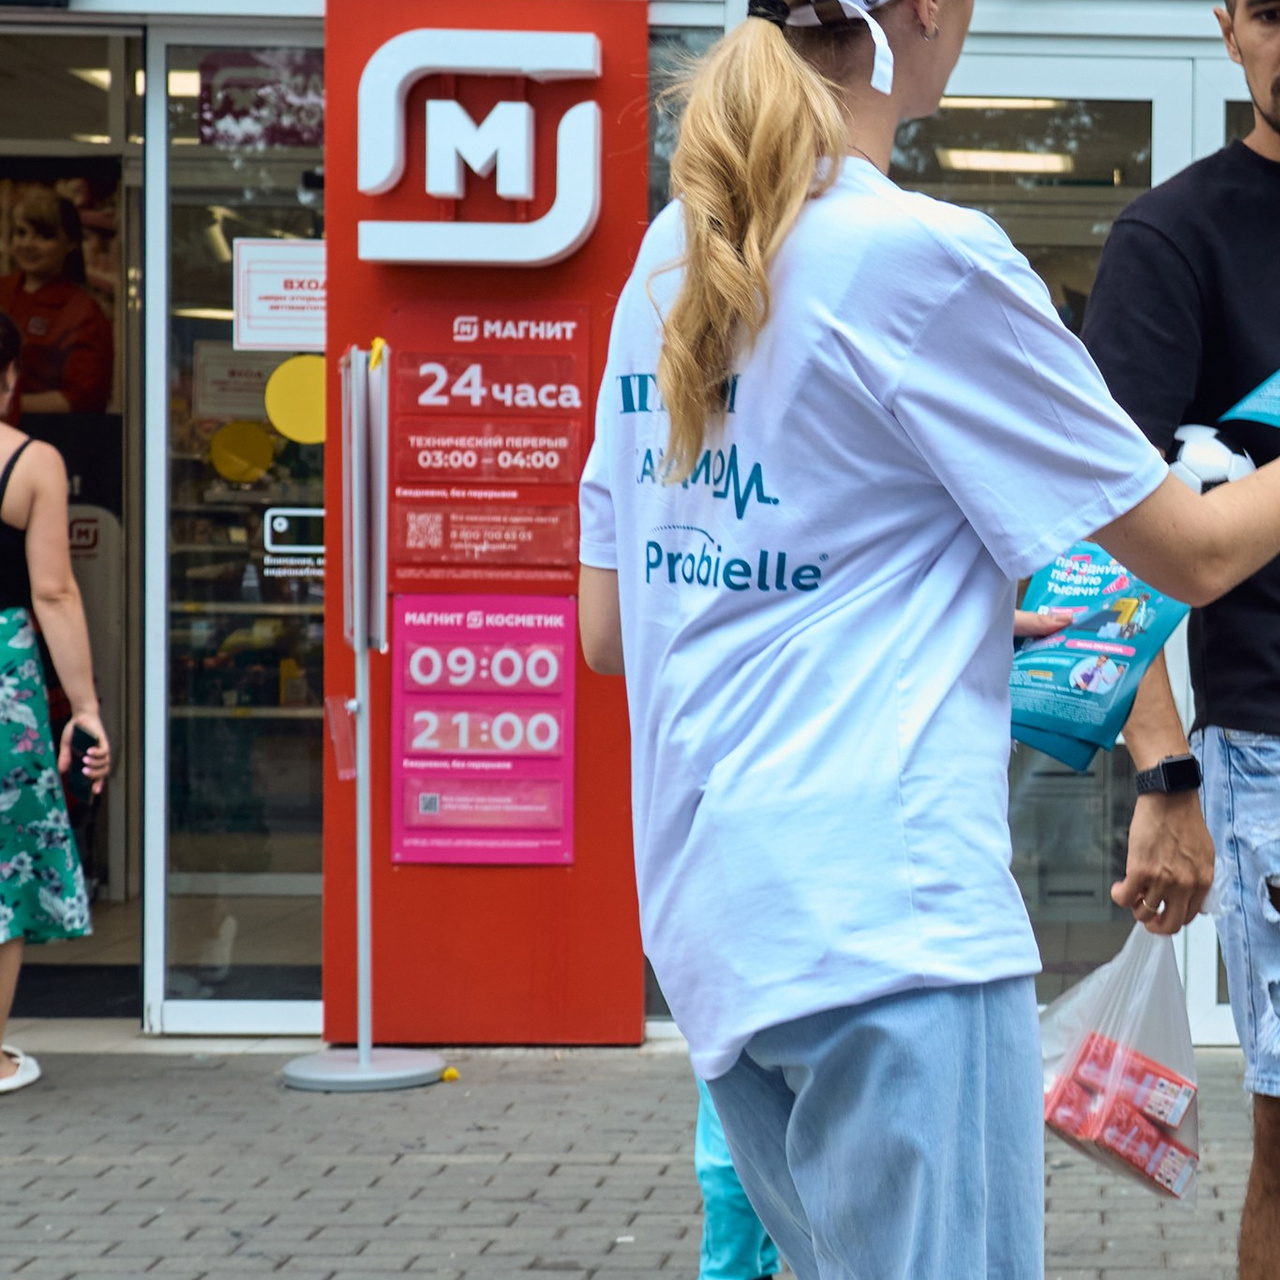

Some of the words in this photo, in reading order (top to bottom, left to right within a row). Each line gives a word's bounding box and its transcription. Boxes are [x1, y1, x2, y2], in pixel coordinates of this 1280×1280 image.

[483, 321, 577, 340] МАГНИТ
[417, 362, 487, 407] 24
[491, 383, 582, 408] часа
[408, 435, 503, 448] ТЕХНИЧЕСКИЙ
[505, 436, 568, 449] ПЕРЕРЫВ
[418, 450, 477, 468] 03:00
[497, 451, 560, 469] 04:00
[1050, 568, 1102, 586] ПЕРВУЮ
[404, 612, 464, 626] МАГНИТ
[485, 612, 565, 628] КОСМЕТИК
[409, 646, 559, 687] 09:00
[411, 710, 559, 751] 21:00
